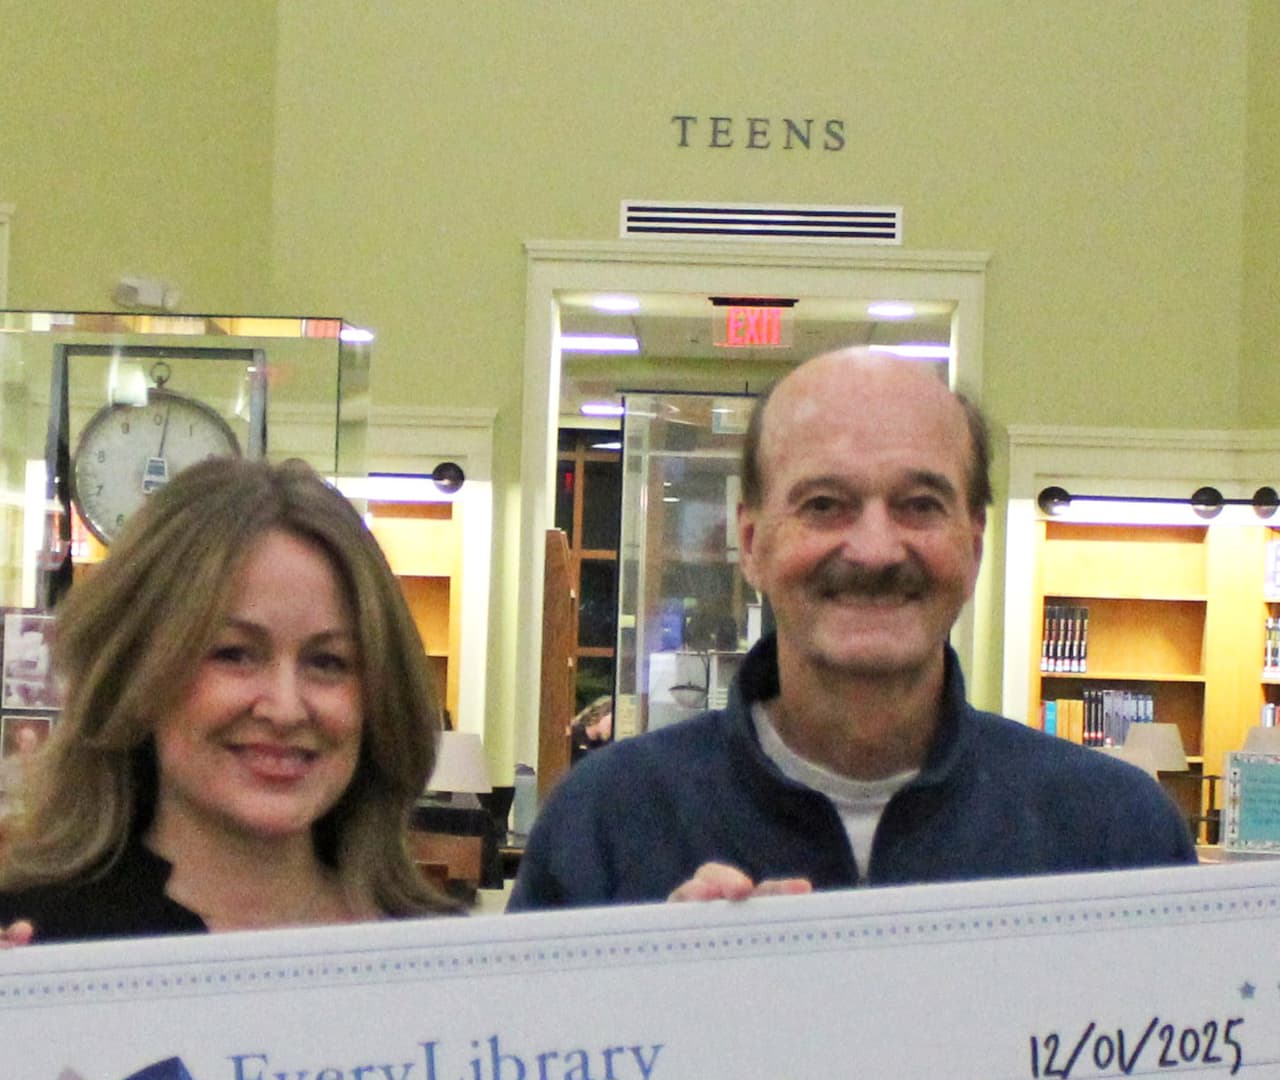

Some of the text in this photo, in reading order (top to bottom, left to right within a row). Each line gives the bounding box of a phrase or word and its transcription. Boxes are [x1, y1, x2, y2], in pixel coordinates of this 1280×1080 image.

[671, 115, 847, 151] TEENS
[727, 307, 783, 345] EXIT
[1028, 1016, 1245, 1080] 12/01/2025
